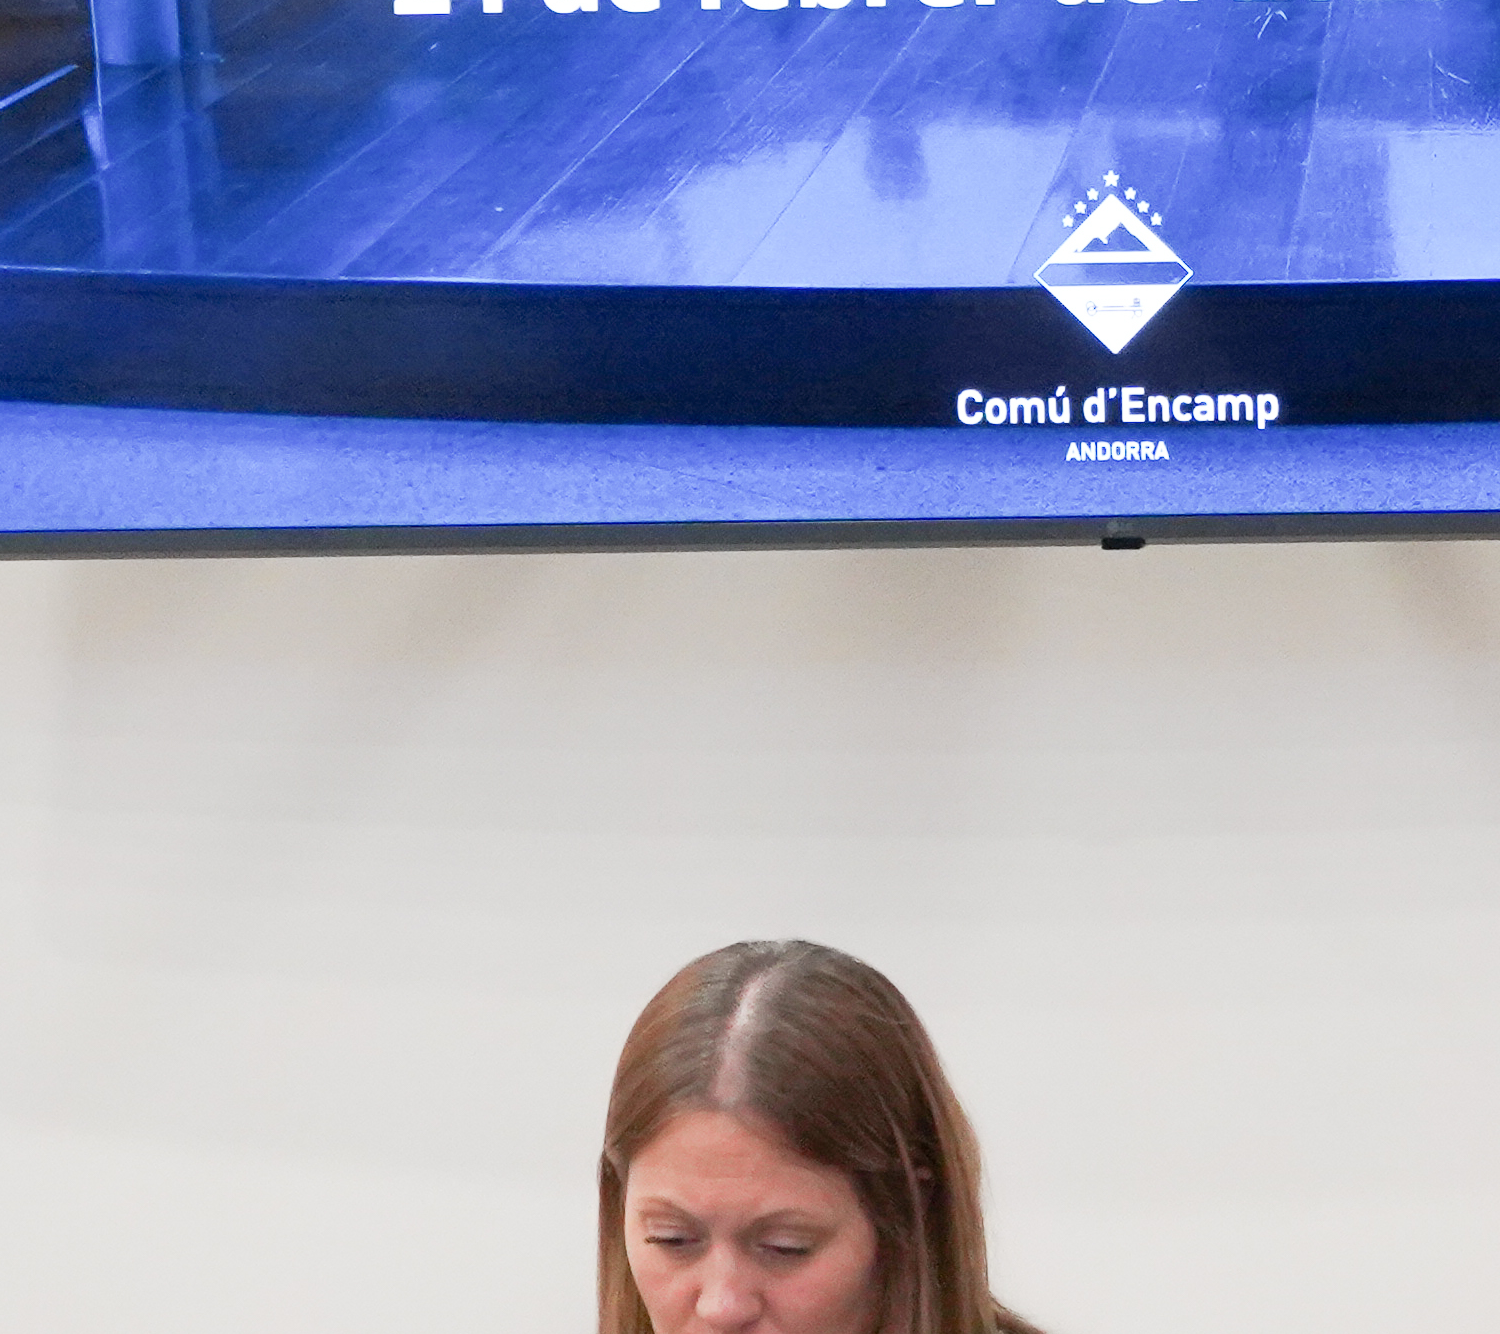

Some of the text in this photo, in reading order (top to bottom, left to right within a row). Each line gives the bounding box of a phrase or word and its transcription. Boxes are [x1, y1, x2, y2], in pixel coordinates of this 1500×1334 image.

[956, 384, 1282, 431] Comú d'Encamp
[1064, 439, 1171, 462] ANDORRA
